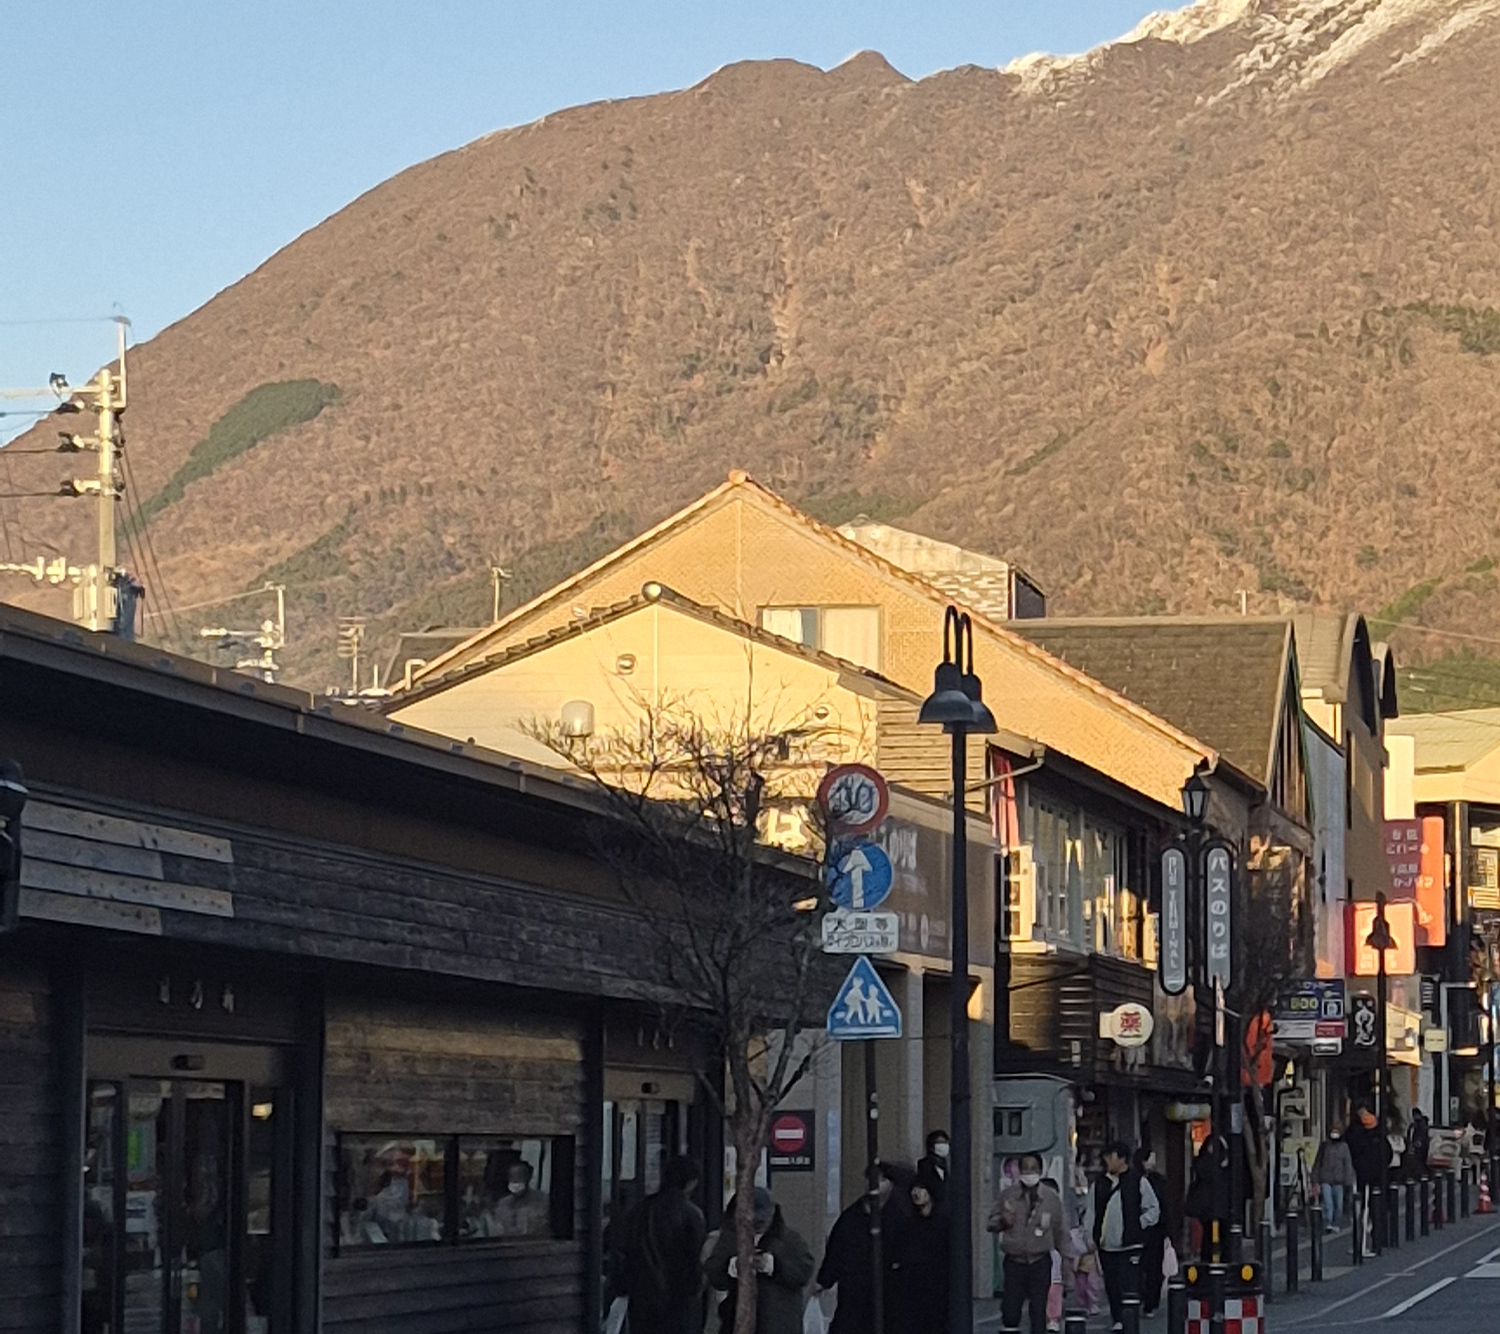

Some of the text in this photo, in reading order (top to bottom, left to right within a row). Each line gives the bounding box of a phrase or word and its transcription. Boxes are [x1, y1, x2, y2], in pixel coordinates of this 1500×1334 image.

[1210, 856, 1228, 959] バスのりば
